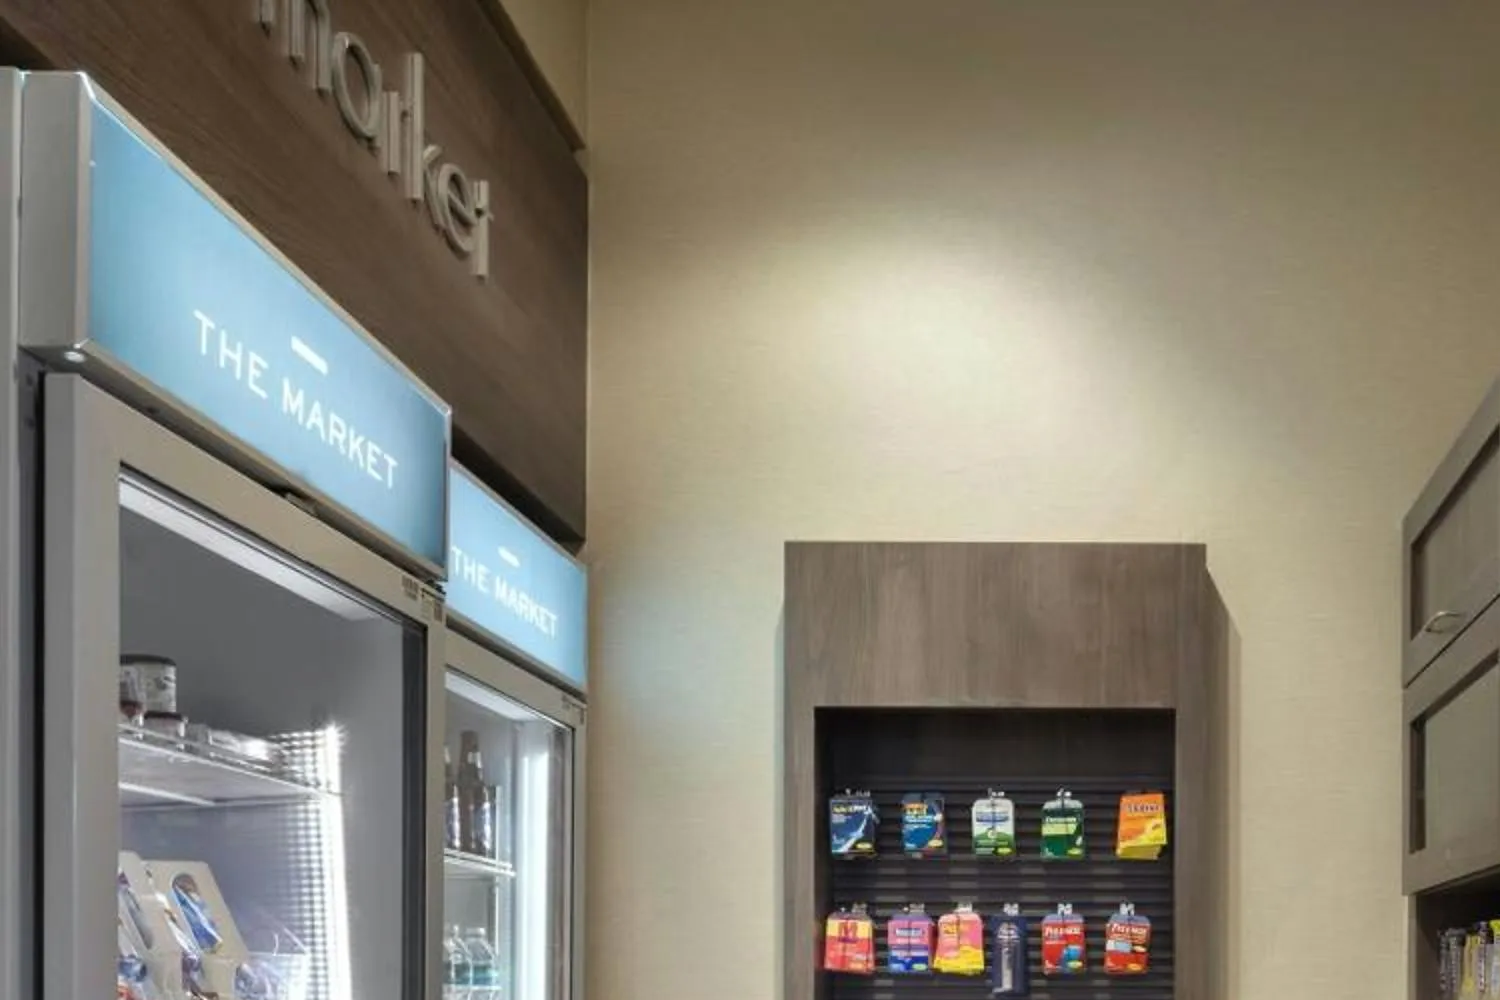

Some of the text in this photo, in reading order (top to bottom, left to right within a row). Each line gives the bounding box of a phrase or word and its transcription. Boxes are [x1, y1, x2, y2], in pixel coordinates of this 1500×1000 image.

[193, 308, 398, 490] THE MARKET
[451, 545, 558, 640] THE MARKET
